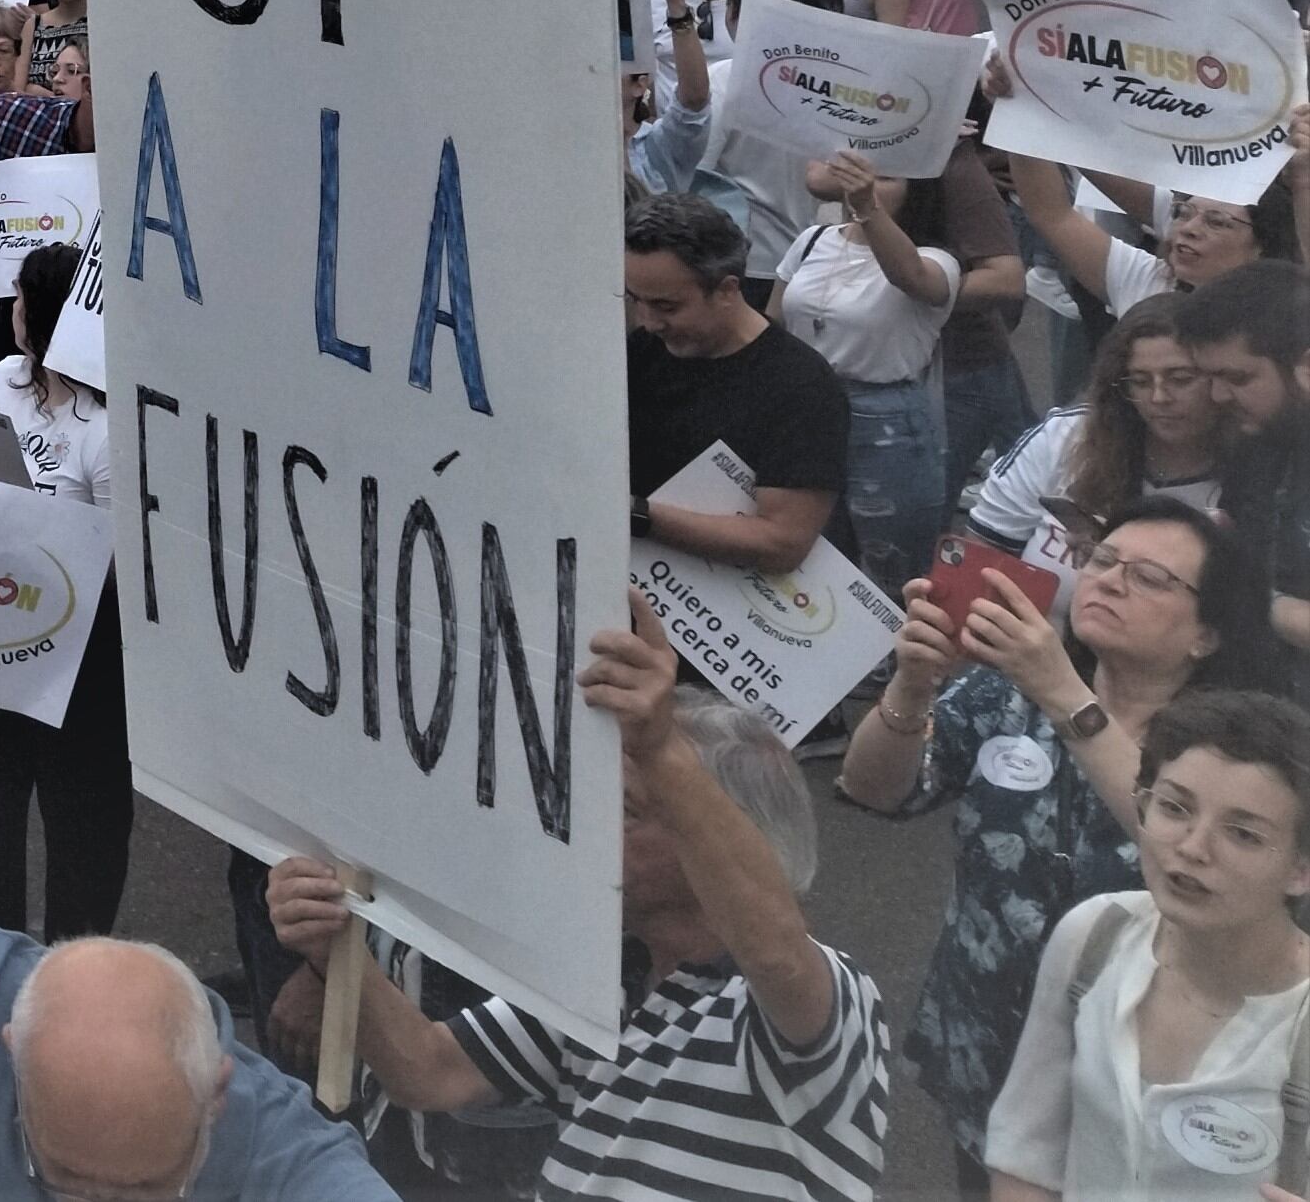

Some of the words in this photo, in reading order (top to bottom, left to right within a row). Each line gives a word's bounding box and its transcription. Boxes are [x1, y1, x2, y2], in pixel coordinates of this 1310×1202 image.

[763, 45, 792, 62] Don
[796, 43, 840, 62] Benito
[816, 97, 880, 127] Futuro
[1111, 75, 1214, 120] Futuro
[847, 125, 920, 151] Villanueva
[1172, 124, 1288, 168] Villanueva
[128, 71, 203, 306] A
[317, 107, 493, 417] LA
[135, 384, 578, 846] FUSIÓN
[650, 560, 723, 632] Quiero
[724, 632, 740, 650] a
[741, 648, 783, 689] mis
[746, 608, 812, 649] Villanueva
[672, 618, 730, 676] cerca
[731, 672, 760, 703] de
